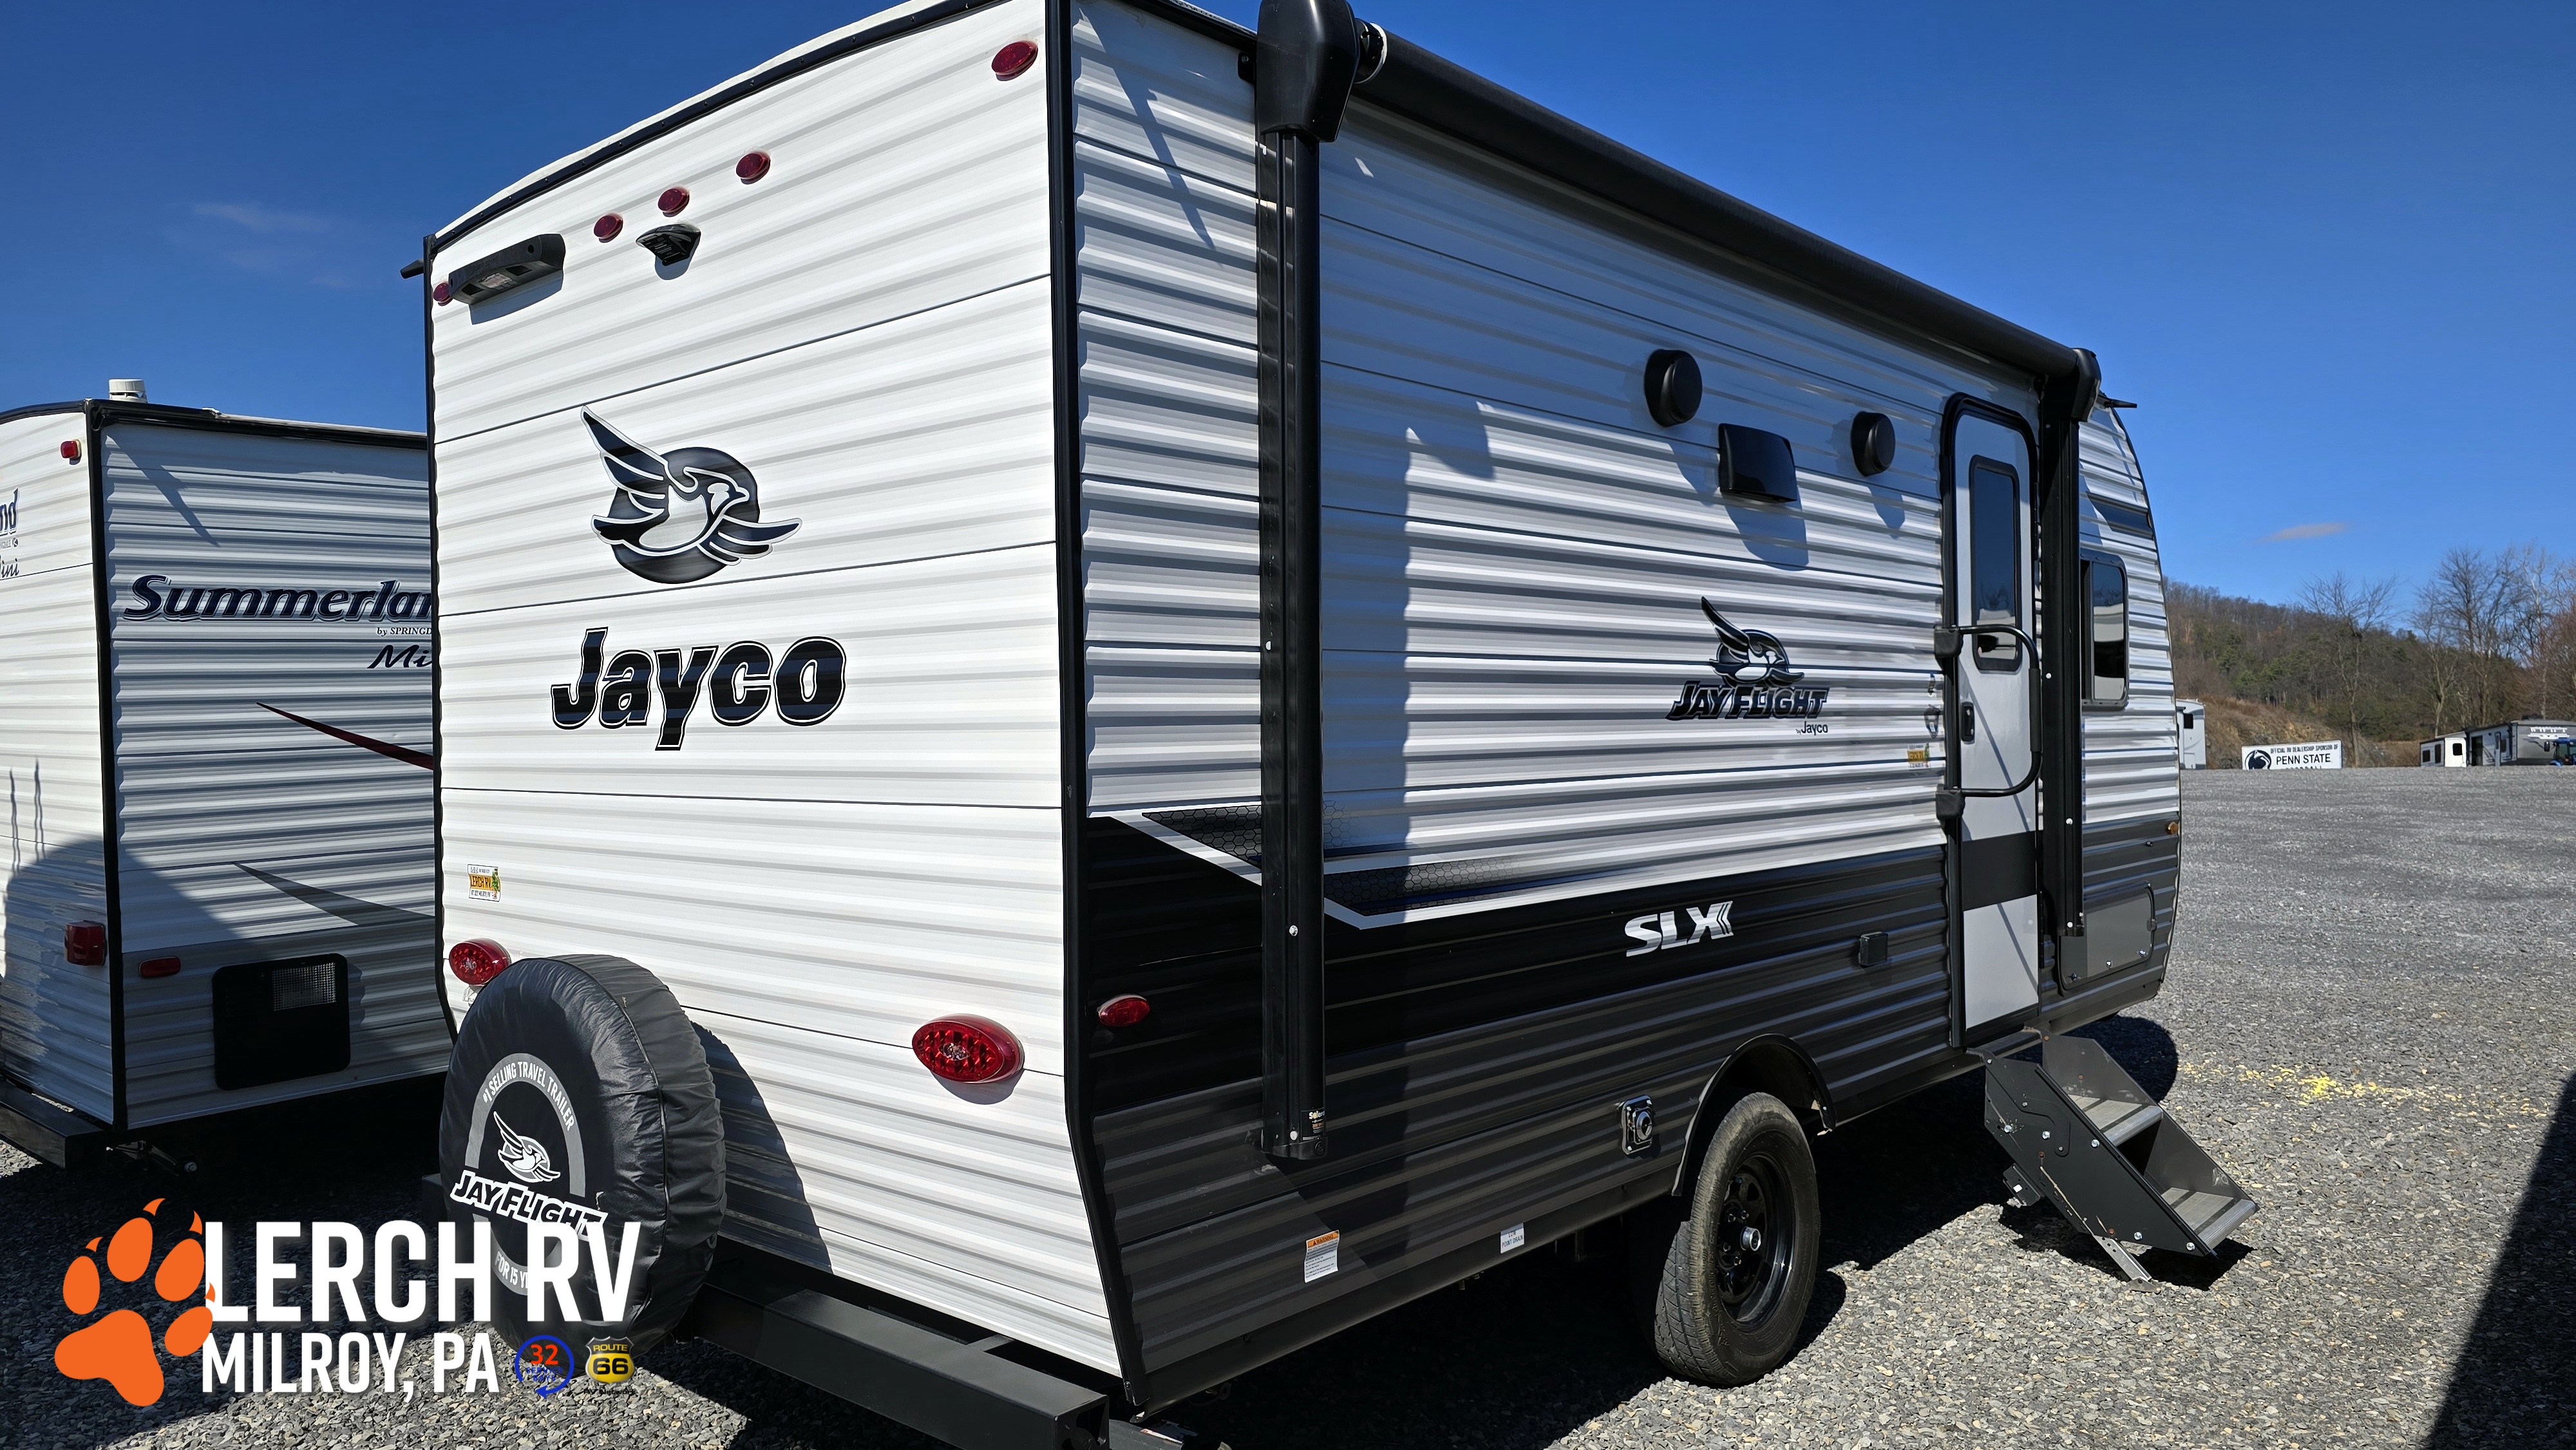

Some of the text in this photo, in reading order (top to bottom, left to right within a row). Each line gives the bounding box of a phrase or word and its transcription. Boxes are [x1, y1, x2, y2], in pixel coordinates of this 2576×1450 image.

[0, 557, 19, 578] ini
[377, 627, 388, 637] by
[551, 626, 846, 751] Jayco
[1801, 721, 1828, 736] Jayco
[2276, 753, 2331, 766] PENN STATE
[1624, 900, 1734, 957] SLX
[482, 1061, 574, 1131] #1 SELLING TRAVEL TRAILER
[1316, 1234, 1334, 1244] WARNING
[494, 1250, 510, 1280] FOR
[509, 1266, 518, 1286] 15
